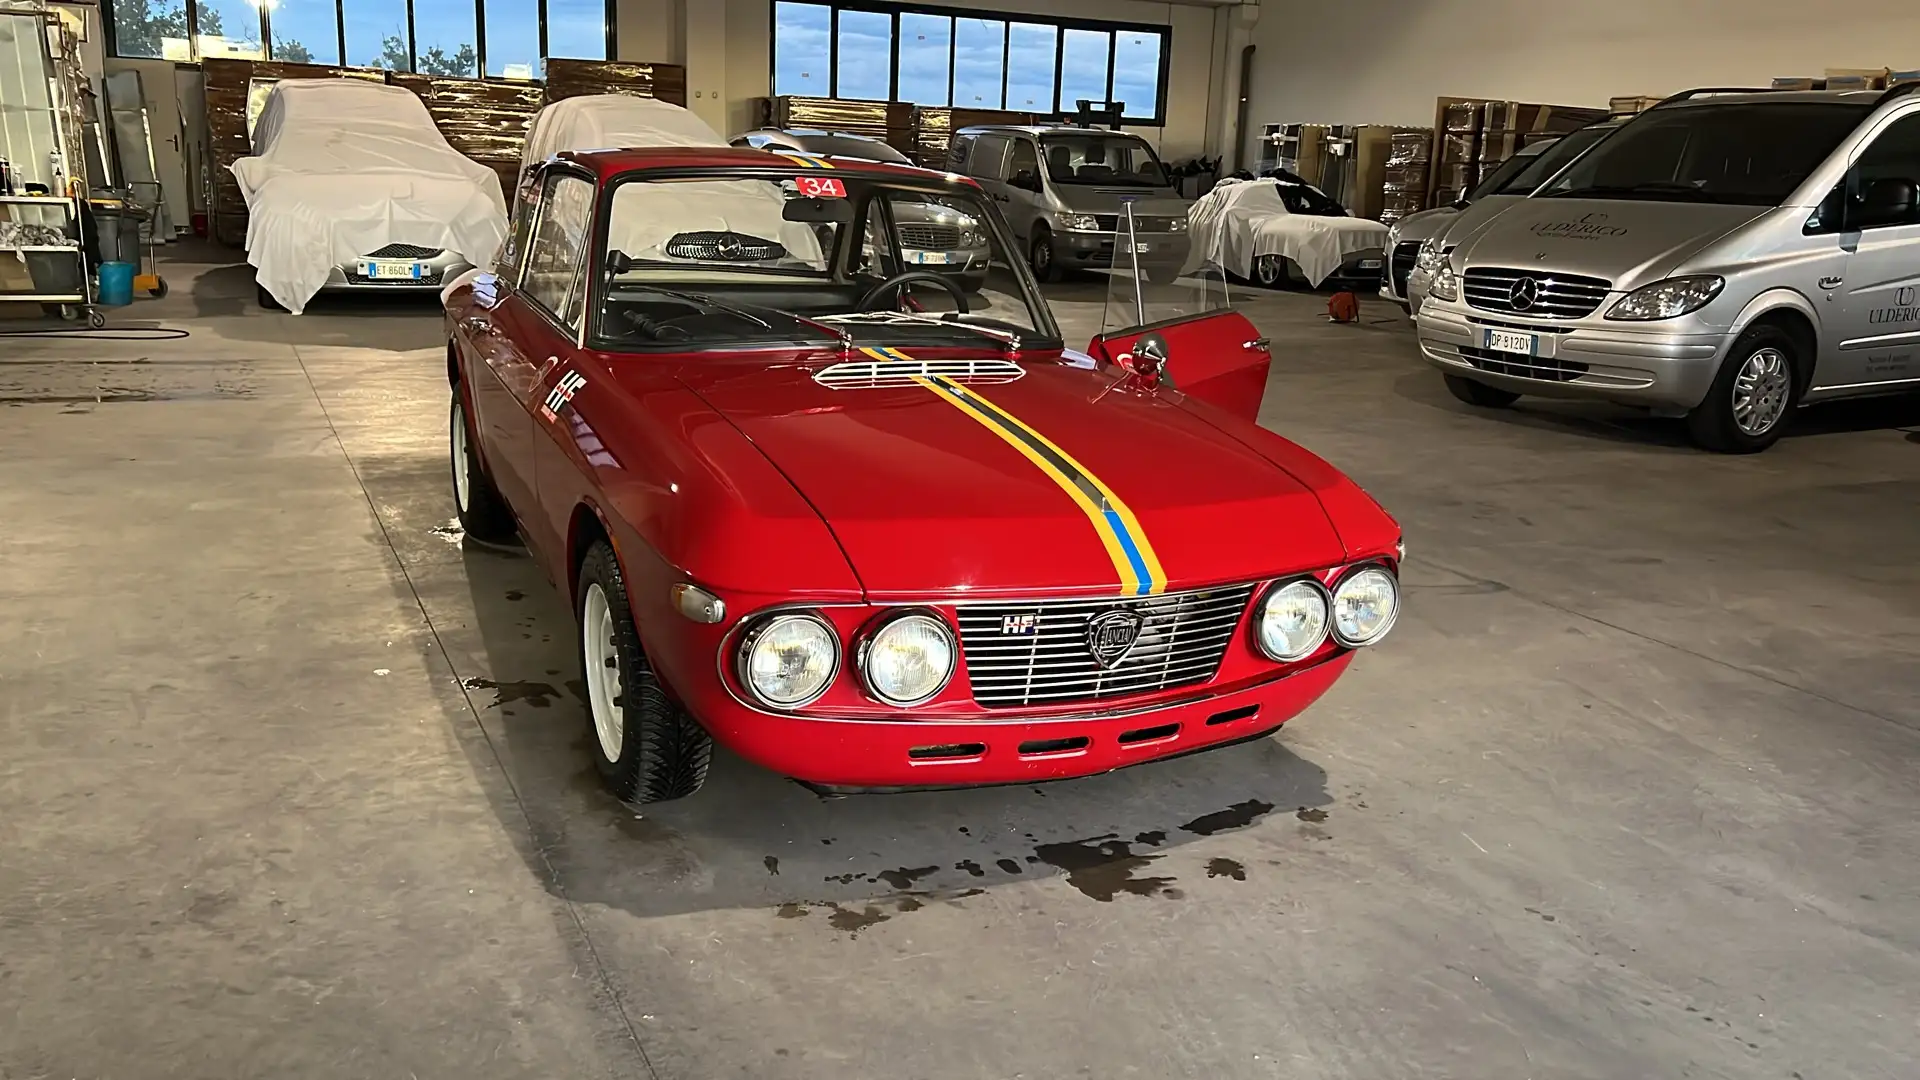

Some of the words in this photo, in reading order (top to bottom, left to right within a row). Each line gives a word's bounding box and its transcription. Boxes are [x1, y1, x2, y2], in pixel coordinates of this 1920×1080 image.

[804, 178, 837, 195] 34
[545, 369, 587, 413] HF
[1002, 615, 1035, 634] HF
